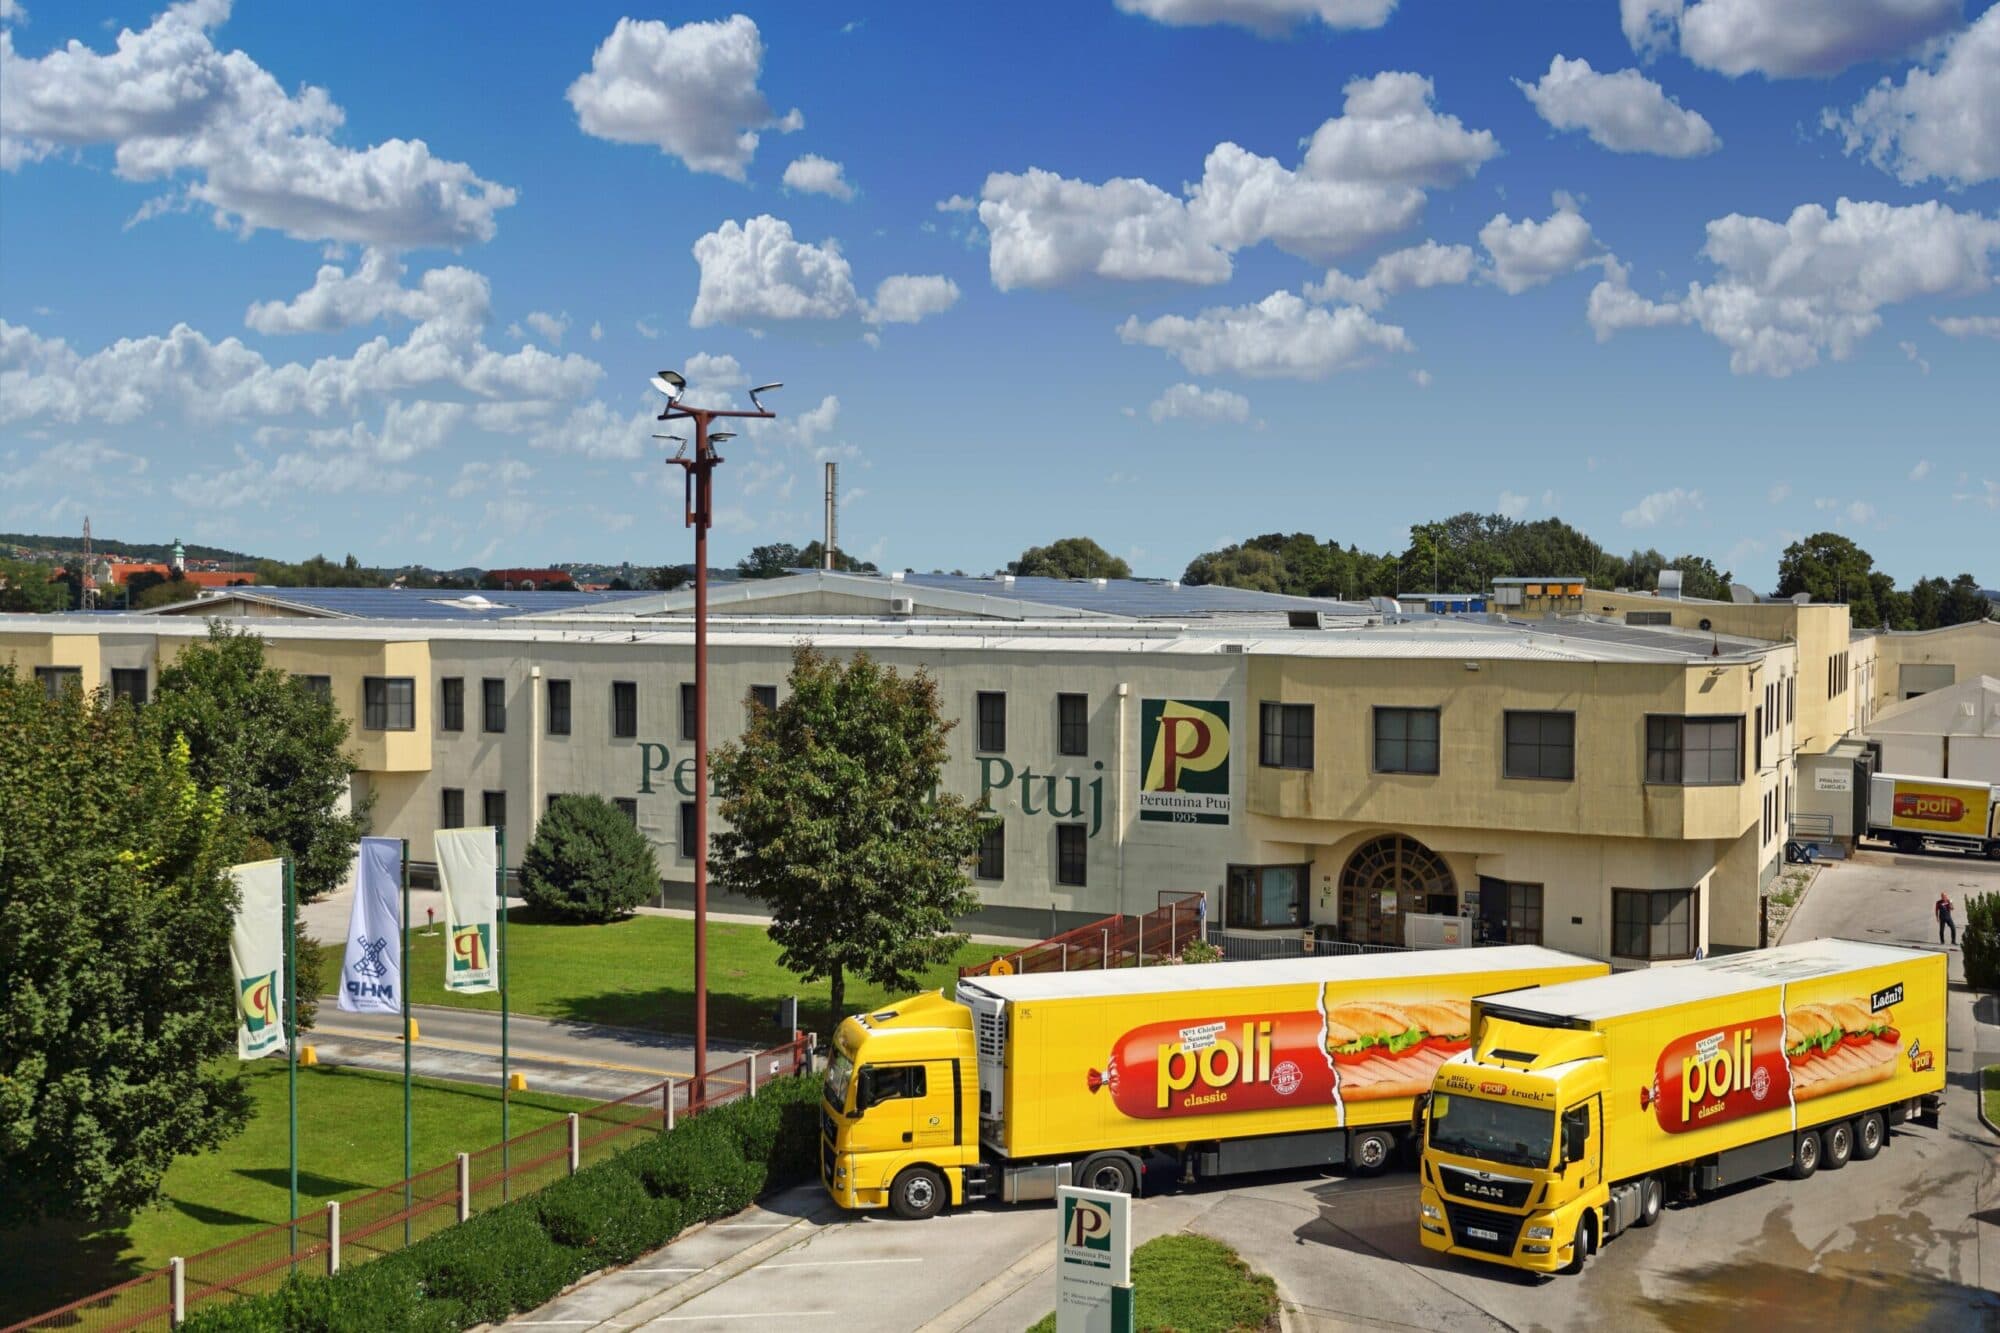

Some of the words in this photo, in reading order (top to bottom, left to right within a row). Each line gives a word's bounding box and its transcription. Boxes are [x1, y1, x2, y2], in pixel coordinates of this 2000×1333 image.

[975, 757, 1105, 839] Ptuj
[1140, 793, 1202, 808] Perutnina
[1205, 797, 1231, 811] Ptuj
[1916, 799, 1951, 815] poli
[1172, 812, 1198, 824] 1905
[1156, 1021, 1272, 1109] poli
[1681, 1028, 1752, 1123] poli
[1184, 1089, 1228, 1108] classic
[1446, 1079, 1475, 1092] tasty
[1511, 1088, 1545, 1102] truck!
[1698, 1100, 1726, 1120] classic
[1464, 1182, 1504, 1198] MAN
